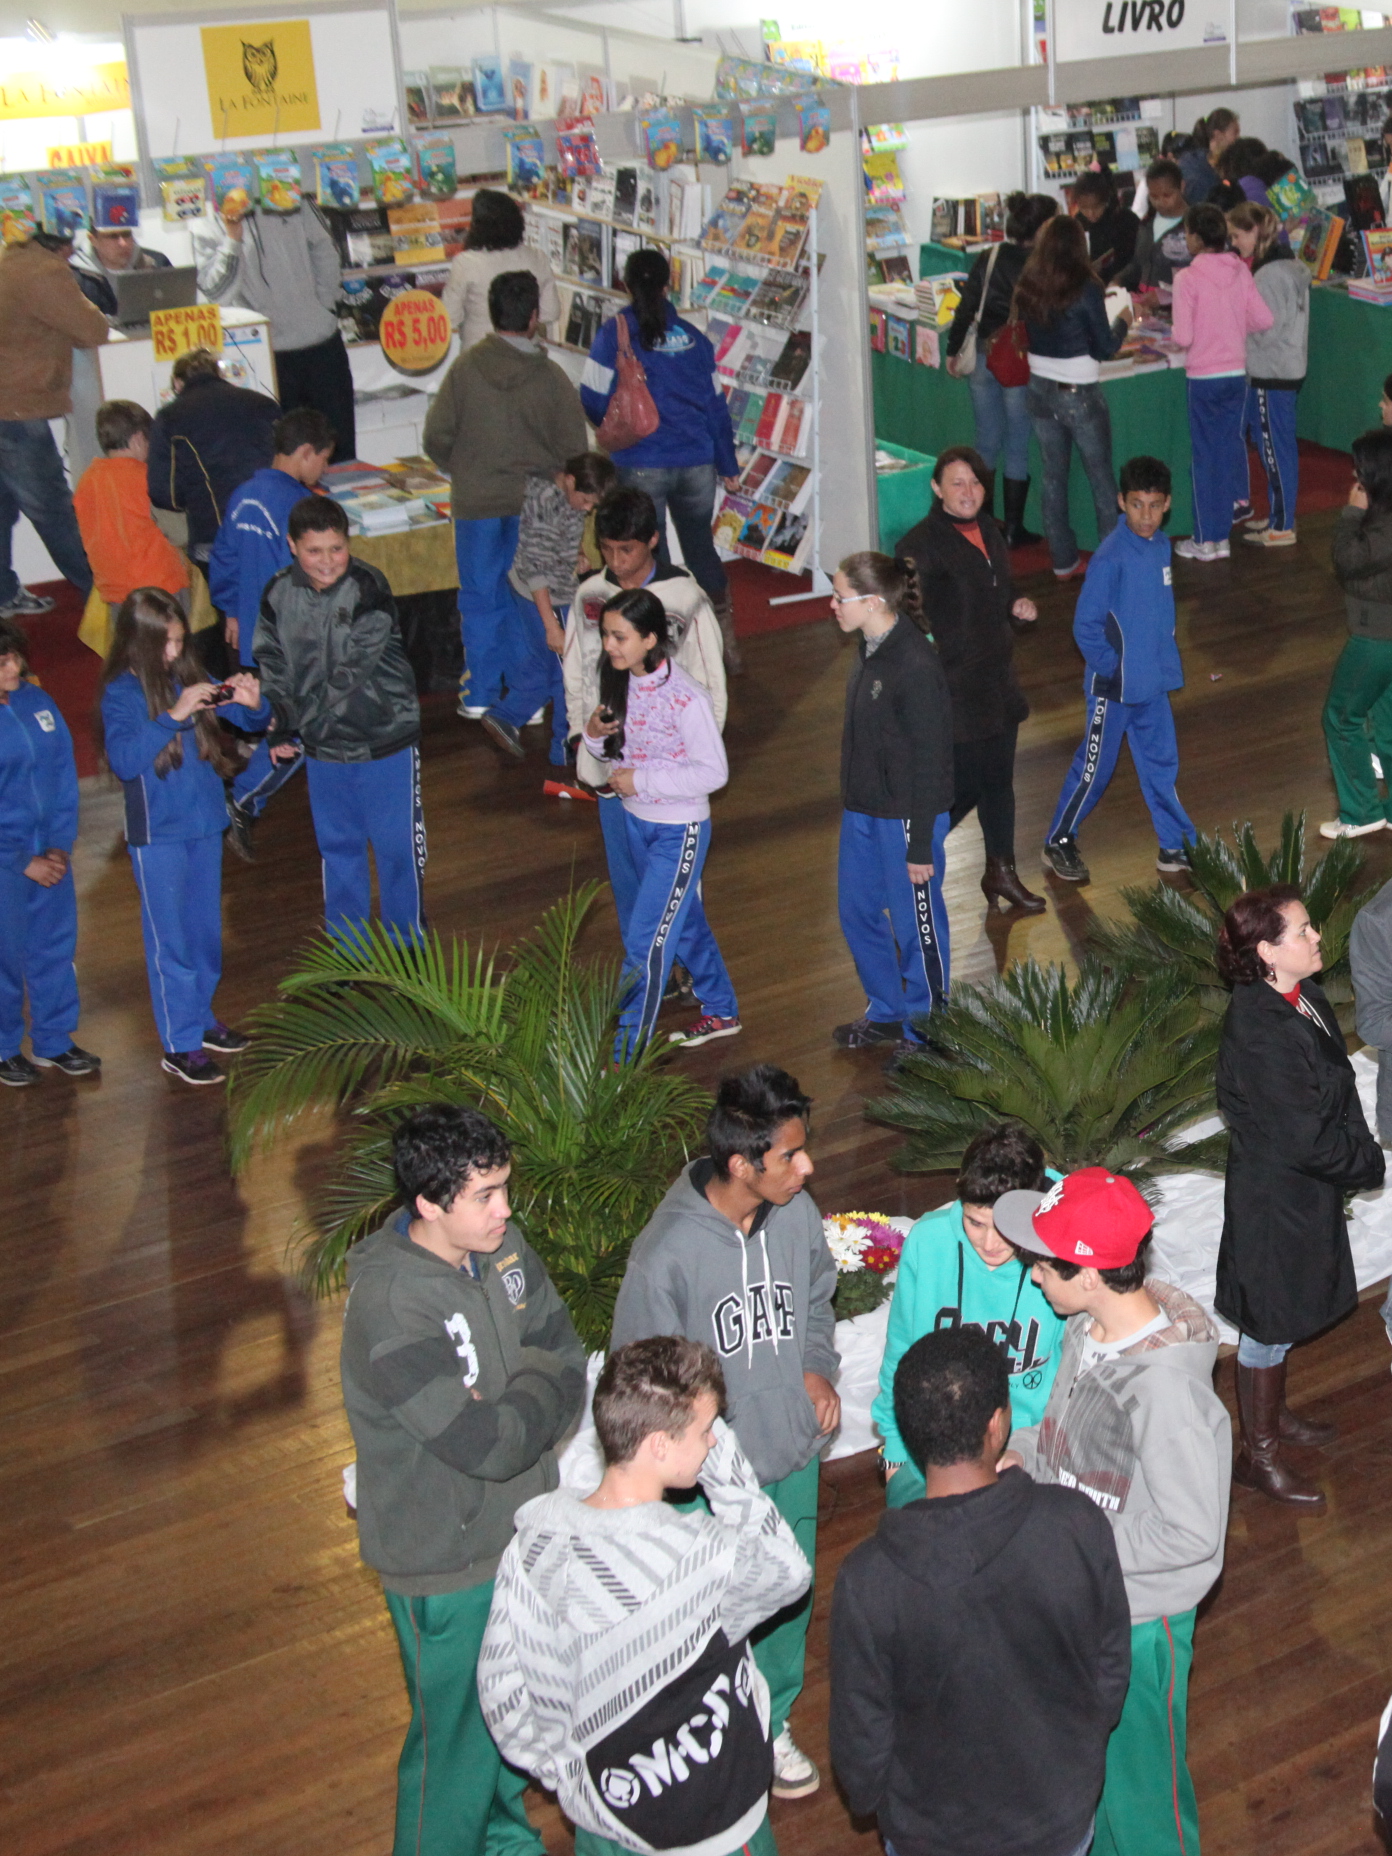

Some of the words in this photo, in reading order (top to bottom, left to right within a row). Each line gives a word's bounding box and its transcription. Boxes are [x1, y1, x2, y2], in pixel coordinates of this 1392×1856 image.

[1102, 0, 1185, 34] LIVRO
[219, 97, 238, 113] LA
[242, 92, 309, 110] FONTAINE
[153, 307, 217, 328] APENAS
[393, 298, 436, 317] APENAS
[154, 327, 178, 355] R$
[383, 320, 407, 350] R$
[412, 315, 448, 352] 5,00
[1093, 697, 1105, 725] OS
[1084, 734, 1099, 783] NOVOS
[681, 822, 699, 874] MPOS
[655, 887, 684, 948] NOVOS
[917, 889, 933, 945] NOVOS
